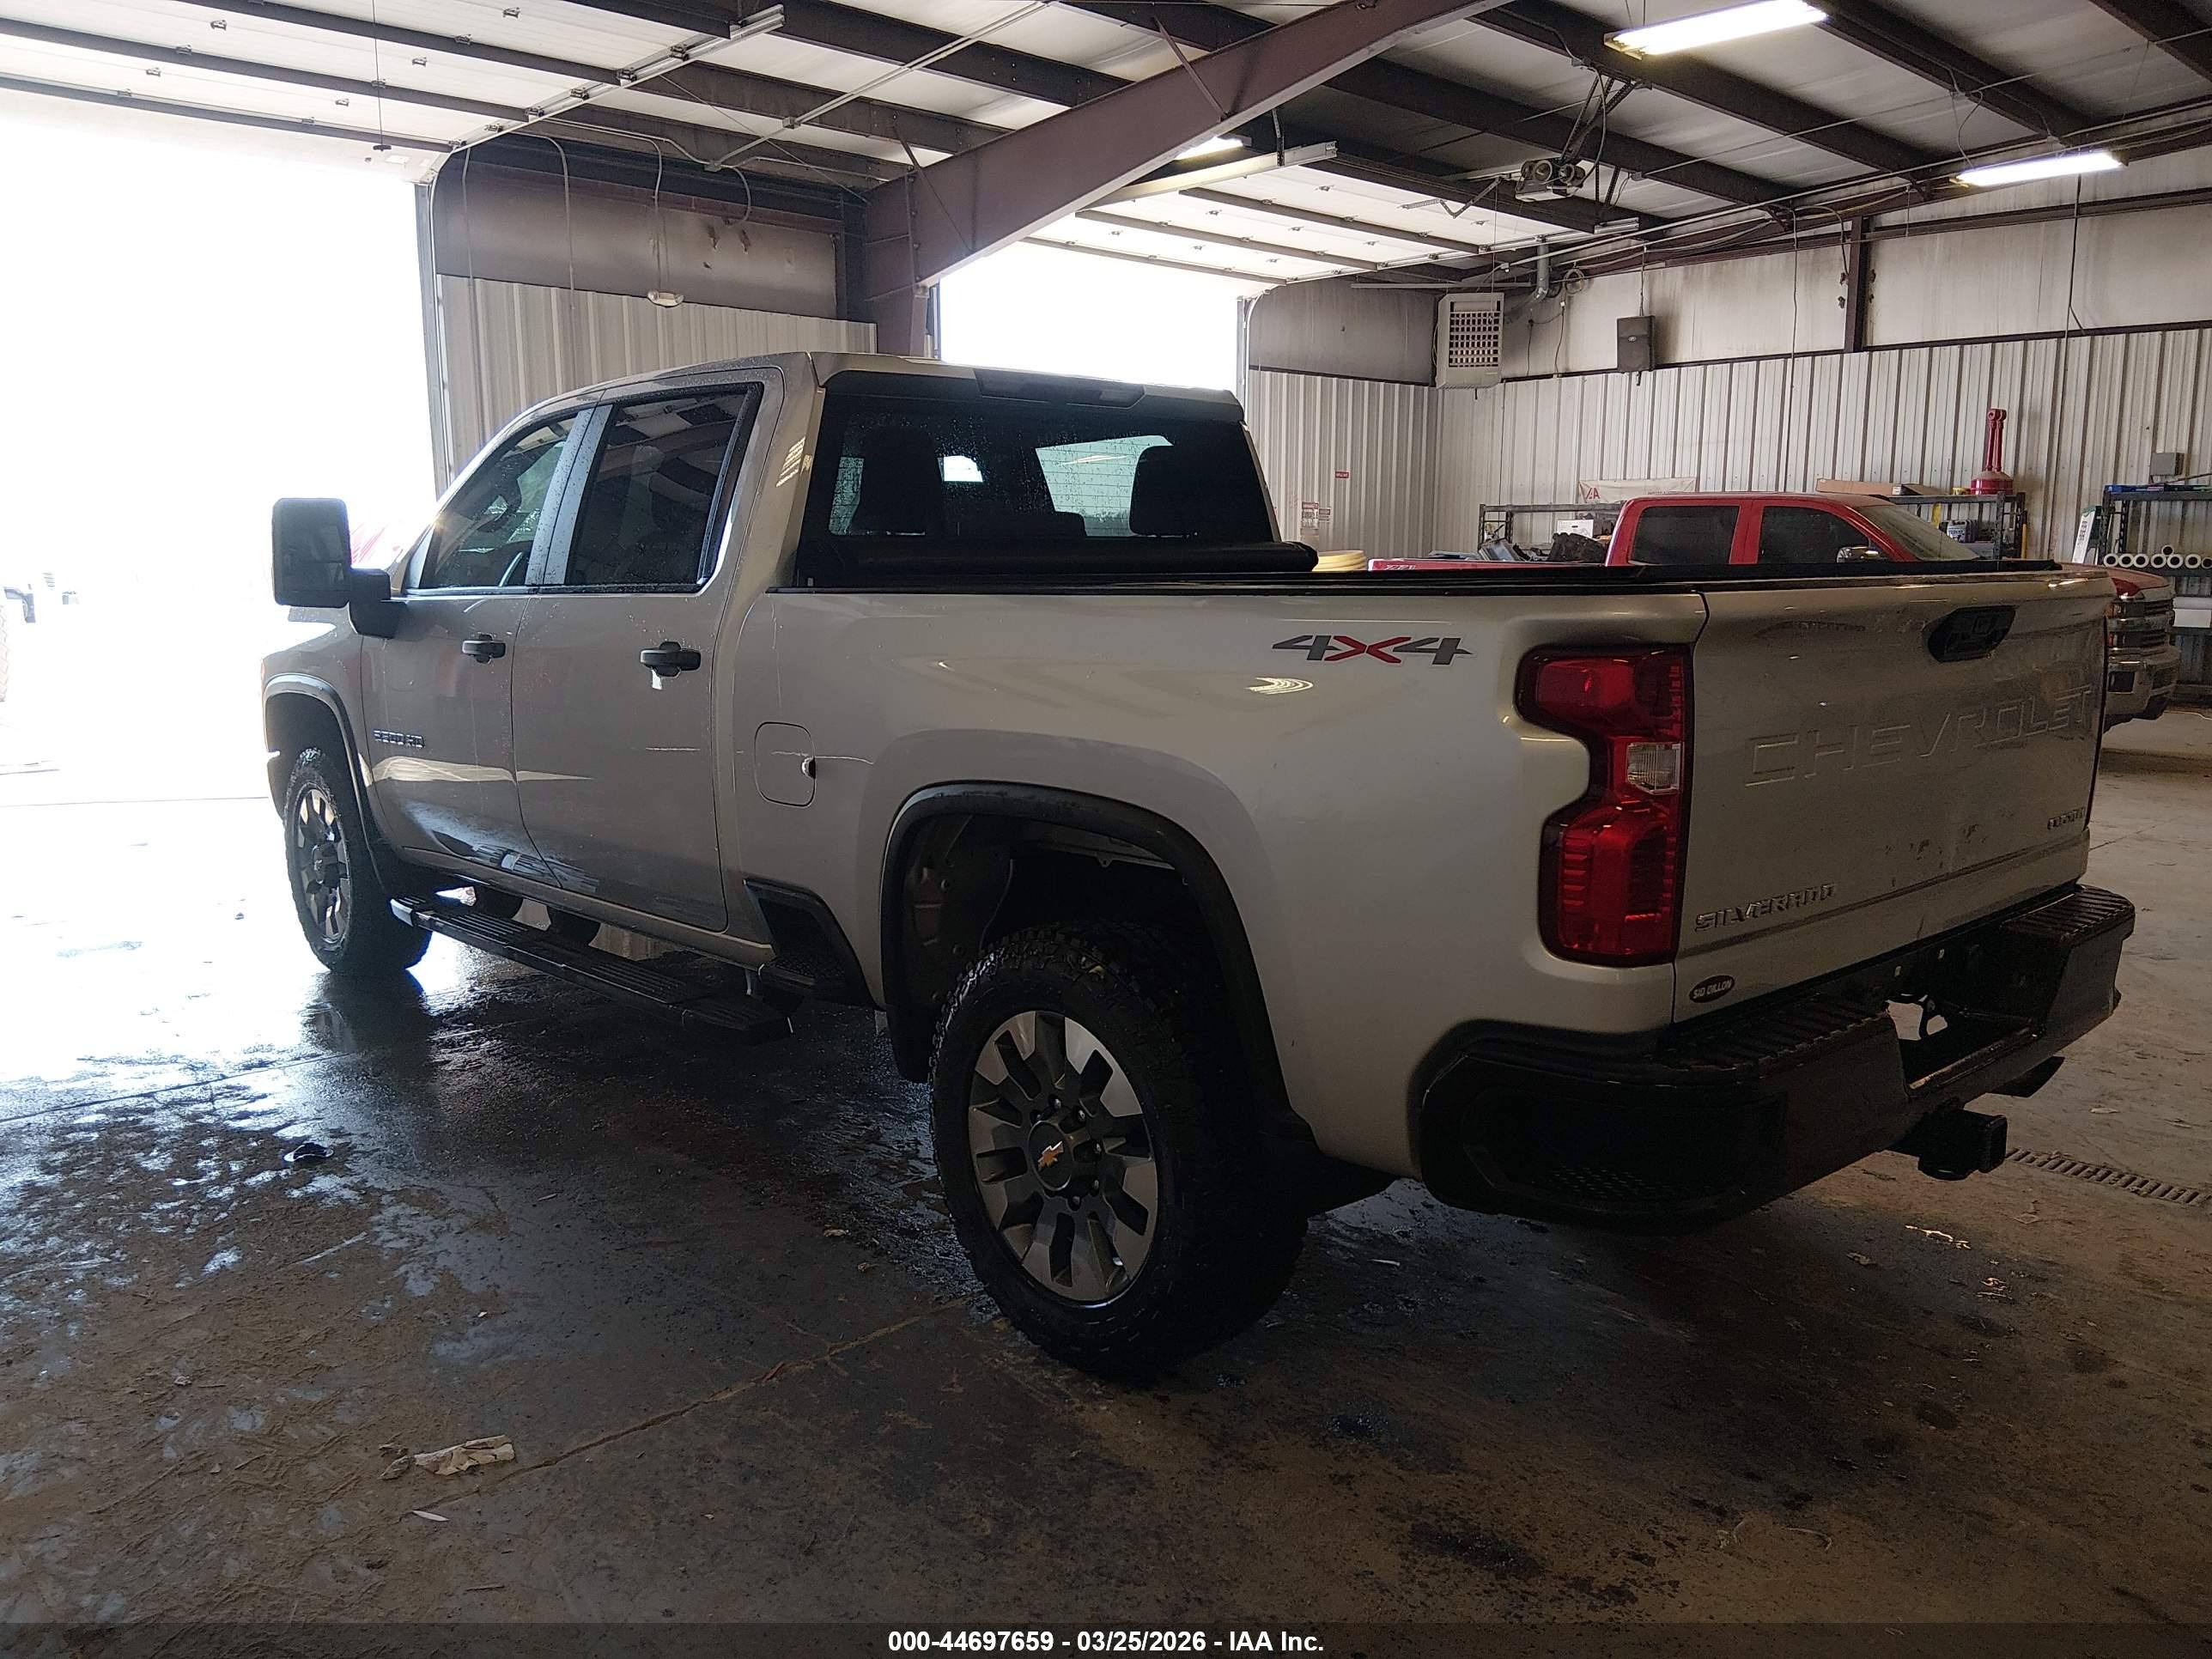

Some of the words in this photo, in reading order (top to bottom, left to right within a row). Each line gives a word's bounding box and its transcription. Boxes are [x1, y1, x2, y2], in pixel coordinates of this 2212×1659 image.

[1744, 684, 2093, 788] CHEVROLET
[1695, 882, 1836, 932] SILVERADO
[1692, 988, 1705, 999] SID
[1706, 978, 1733, 995] DILLON
